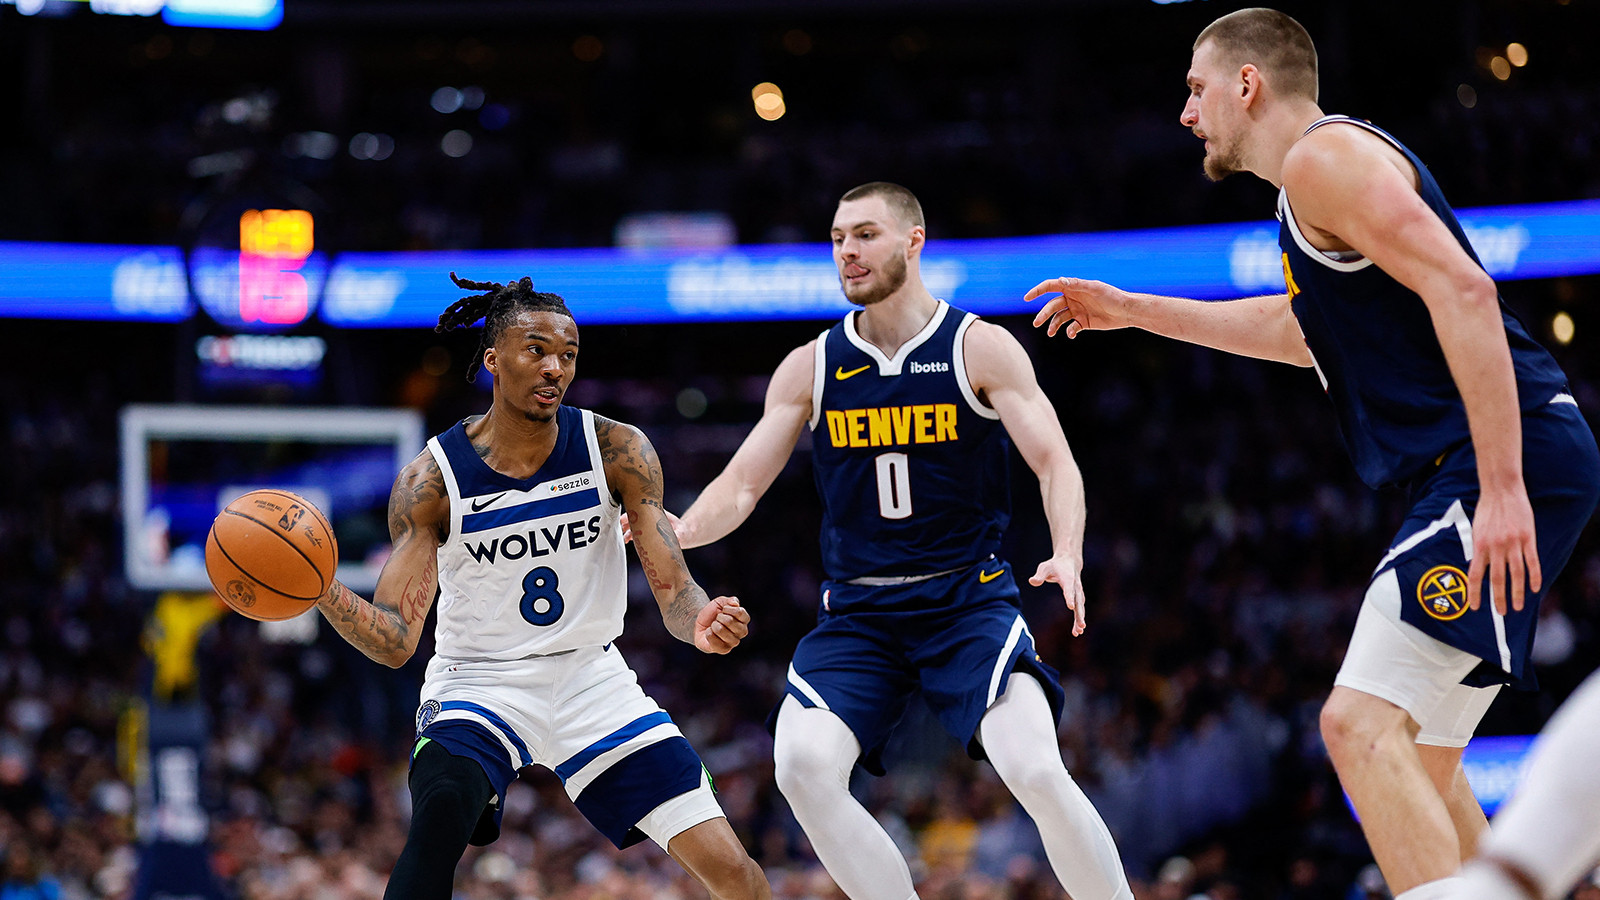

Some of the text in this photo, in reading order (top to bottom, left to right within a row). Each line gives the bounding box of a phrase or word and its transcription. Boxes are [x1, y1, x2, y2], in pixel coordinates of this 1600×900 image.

[910, 361, 949, 374] ibotta
[825, 403, 958, 448] DENVER
[557, 477, 590, 492] sezzle
[875, 452, 913, 520] 0
[463, 515, 602, 565] WOLVES
[519, 566, 565, 627] 8
